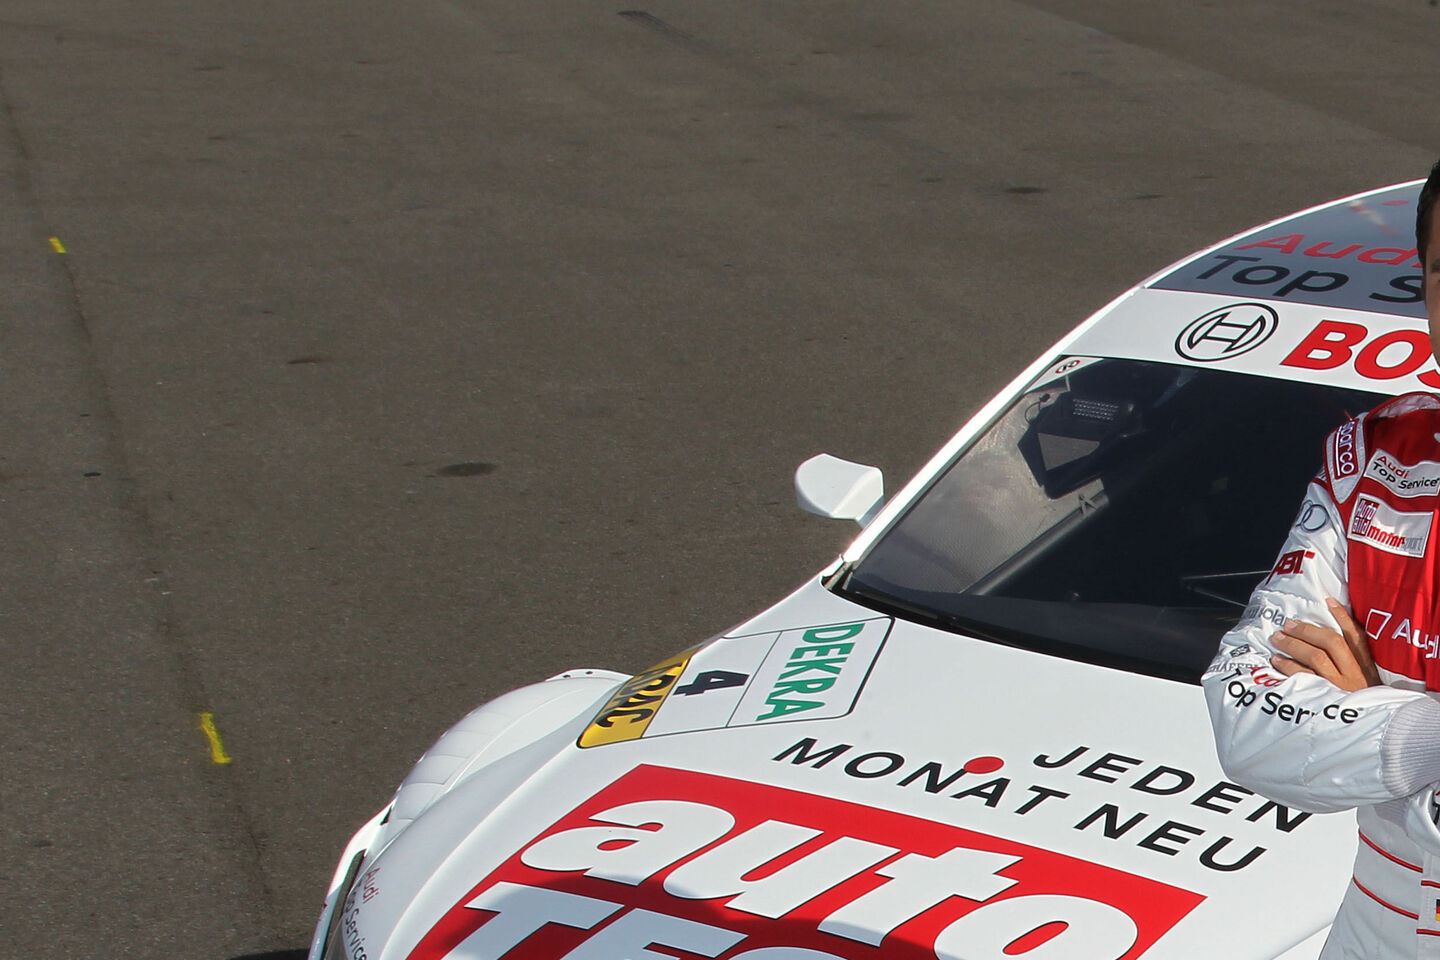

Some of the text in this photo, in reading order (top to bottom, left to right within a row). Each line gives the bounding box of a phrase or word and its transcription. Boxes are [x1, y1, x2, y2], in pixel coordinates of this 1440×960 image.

[1234, 234, 1424, 268] Aud
[1196, 254, 1349, 297] Top
[1373, 462, 1439, 490] Top Service
[1376, 456, 1410, 479] Audi
[673, 670, 750, 696] 4
[755, 623, 866, 722] DEKRA
[1221, 668, 1360, 725] Top Serce
[772, 737, 1267, 873] MONAT NEU
[1033, 746, 1312, 833] JEDEN
[363, 868, 381, 904] Audi
